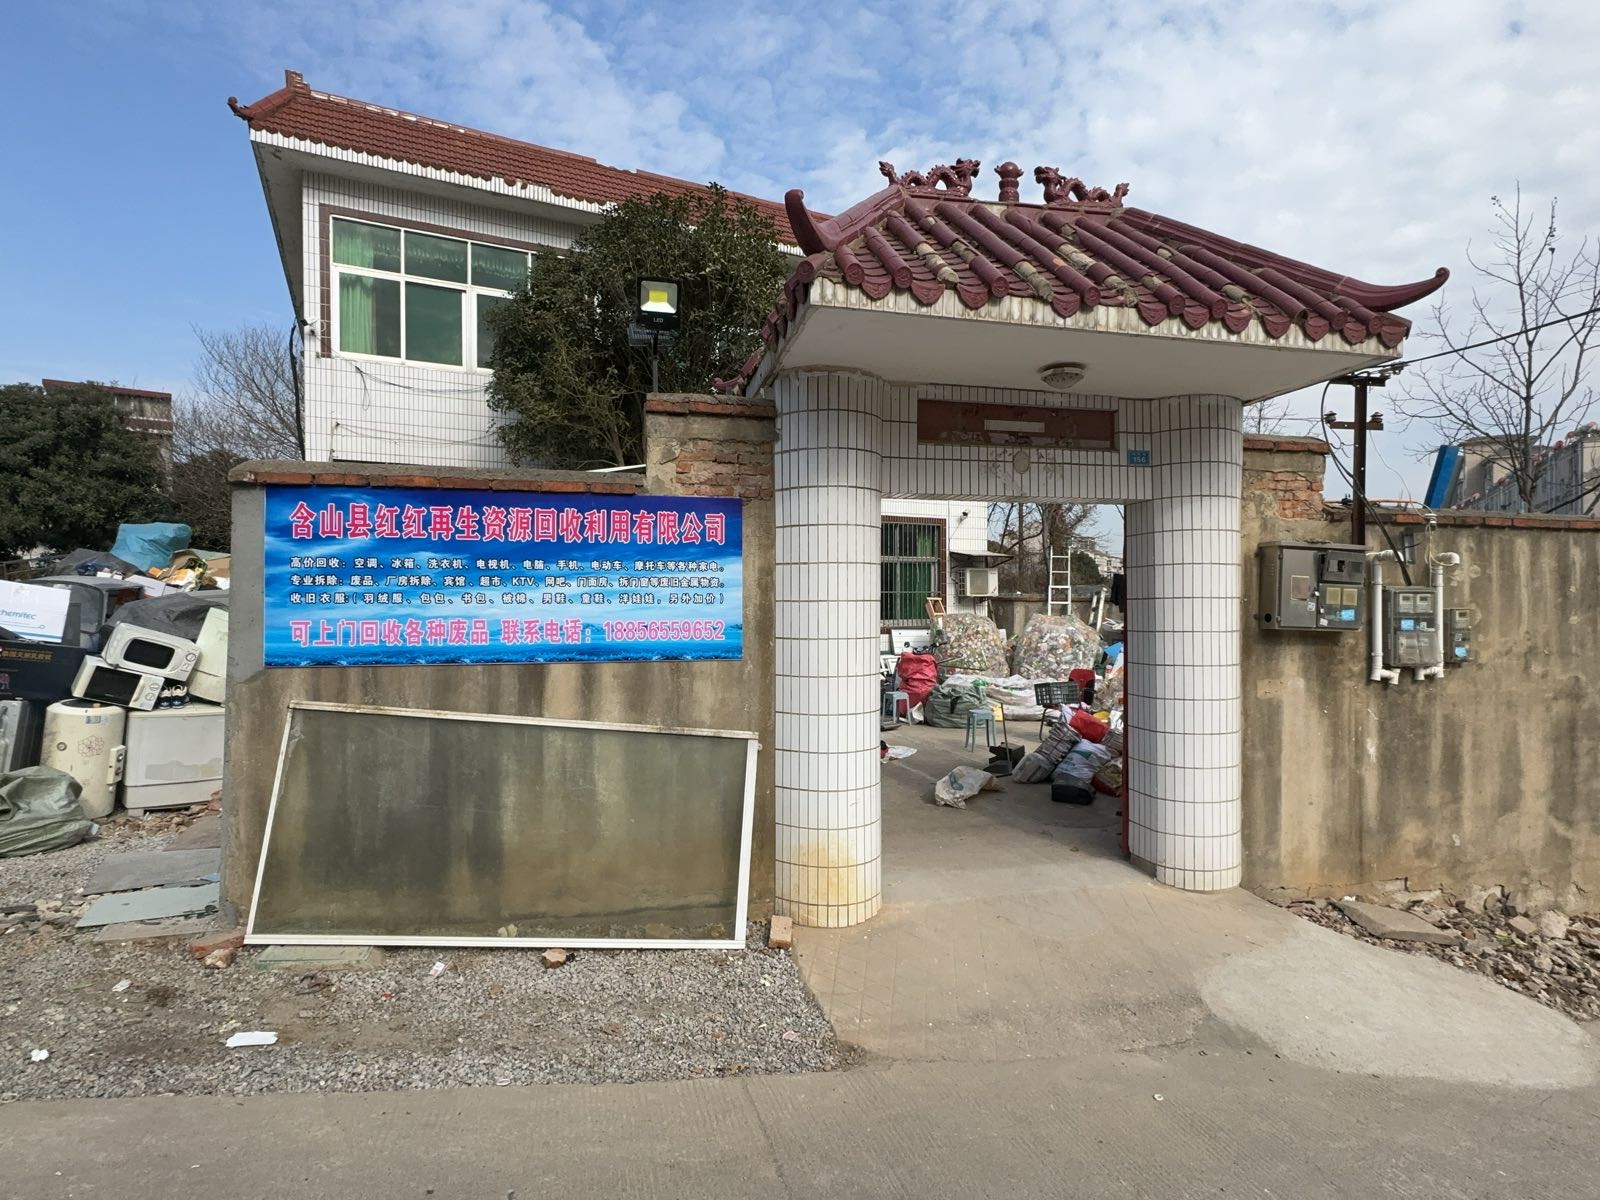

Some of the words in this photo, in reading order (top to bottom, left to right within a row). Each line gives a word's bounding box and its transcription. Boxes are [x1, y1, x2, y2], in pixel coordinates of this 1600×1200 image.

[289, 501, 726, 545] 含山县红红再生资源回收利用有限公司
[290, 618, 490, 647] 可上门回收各种废品
[603, 619, 726, 641] 18856559652
